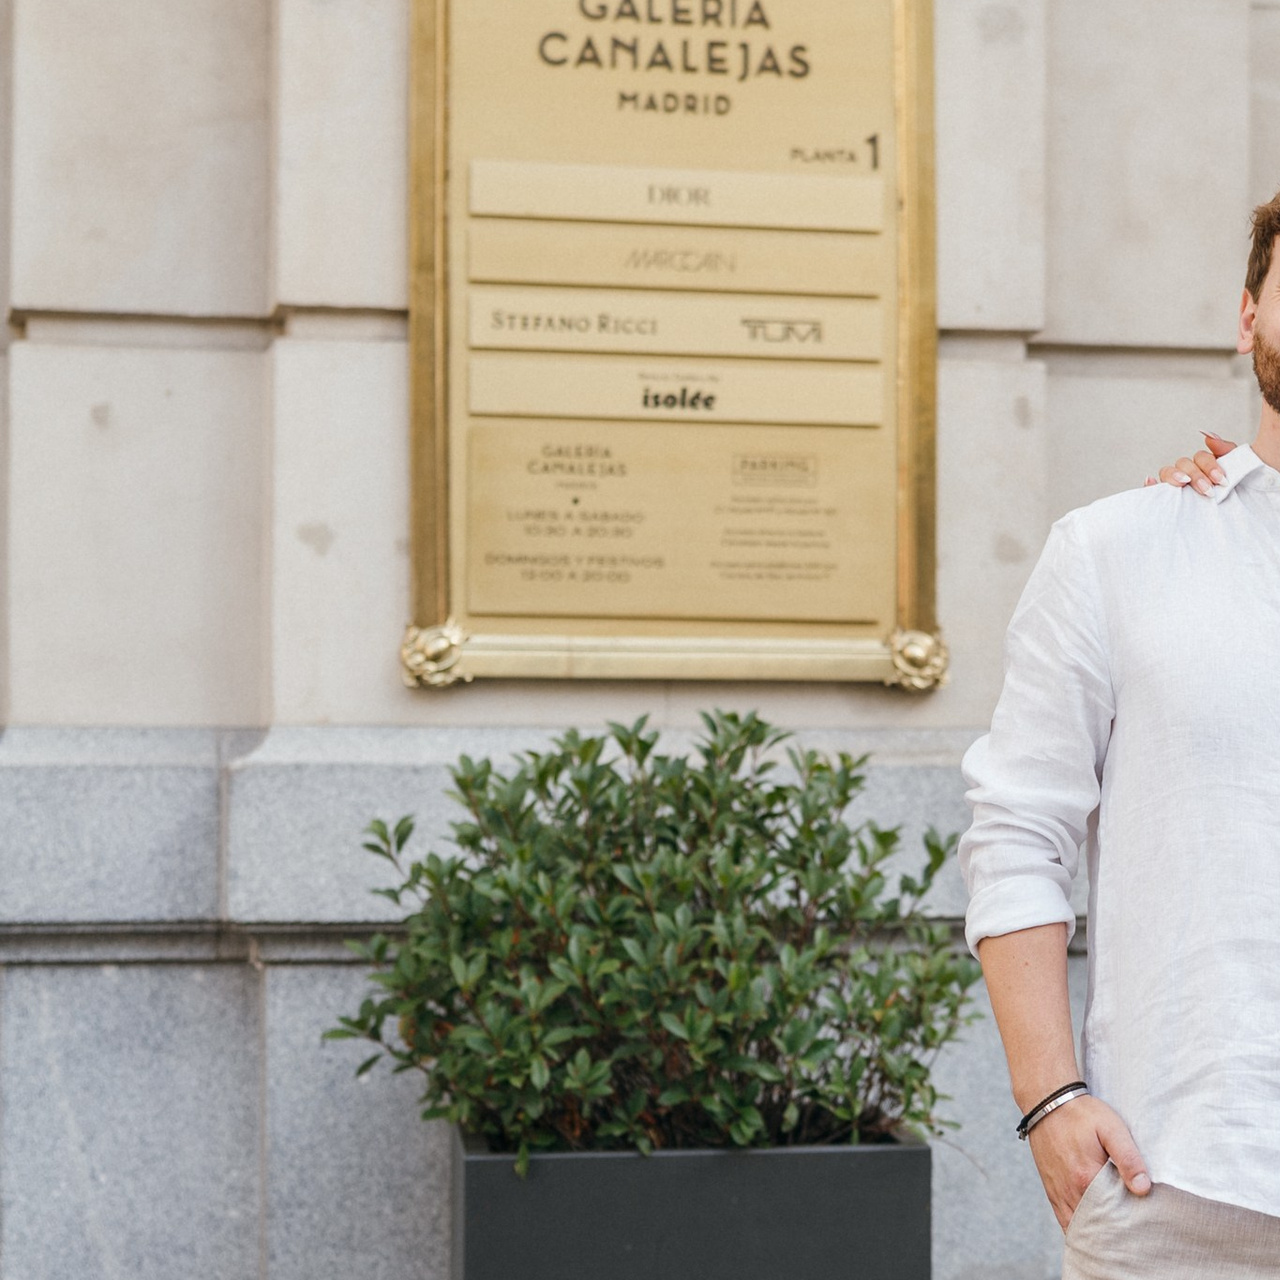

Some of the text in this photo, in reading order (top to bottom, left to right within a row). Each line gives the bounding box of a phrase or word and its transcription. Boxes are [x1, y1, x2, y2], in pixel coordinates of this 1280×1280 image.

[537, 31, 812, 82] CANALEJAS
[617, 91, 733, 116] MADRID
[790, 133, 880, 171] PLANTA 1
[647, 184, 711, 206] DIOR
[490, 308, 658, 336] STEFANO RICCI
[741, 318, 824, 344] TUMI
[641, 386, 716, 411] isolée
